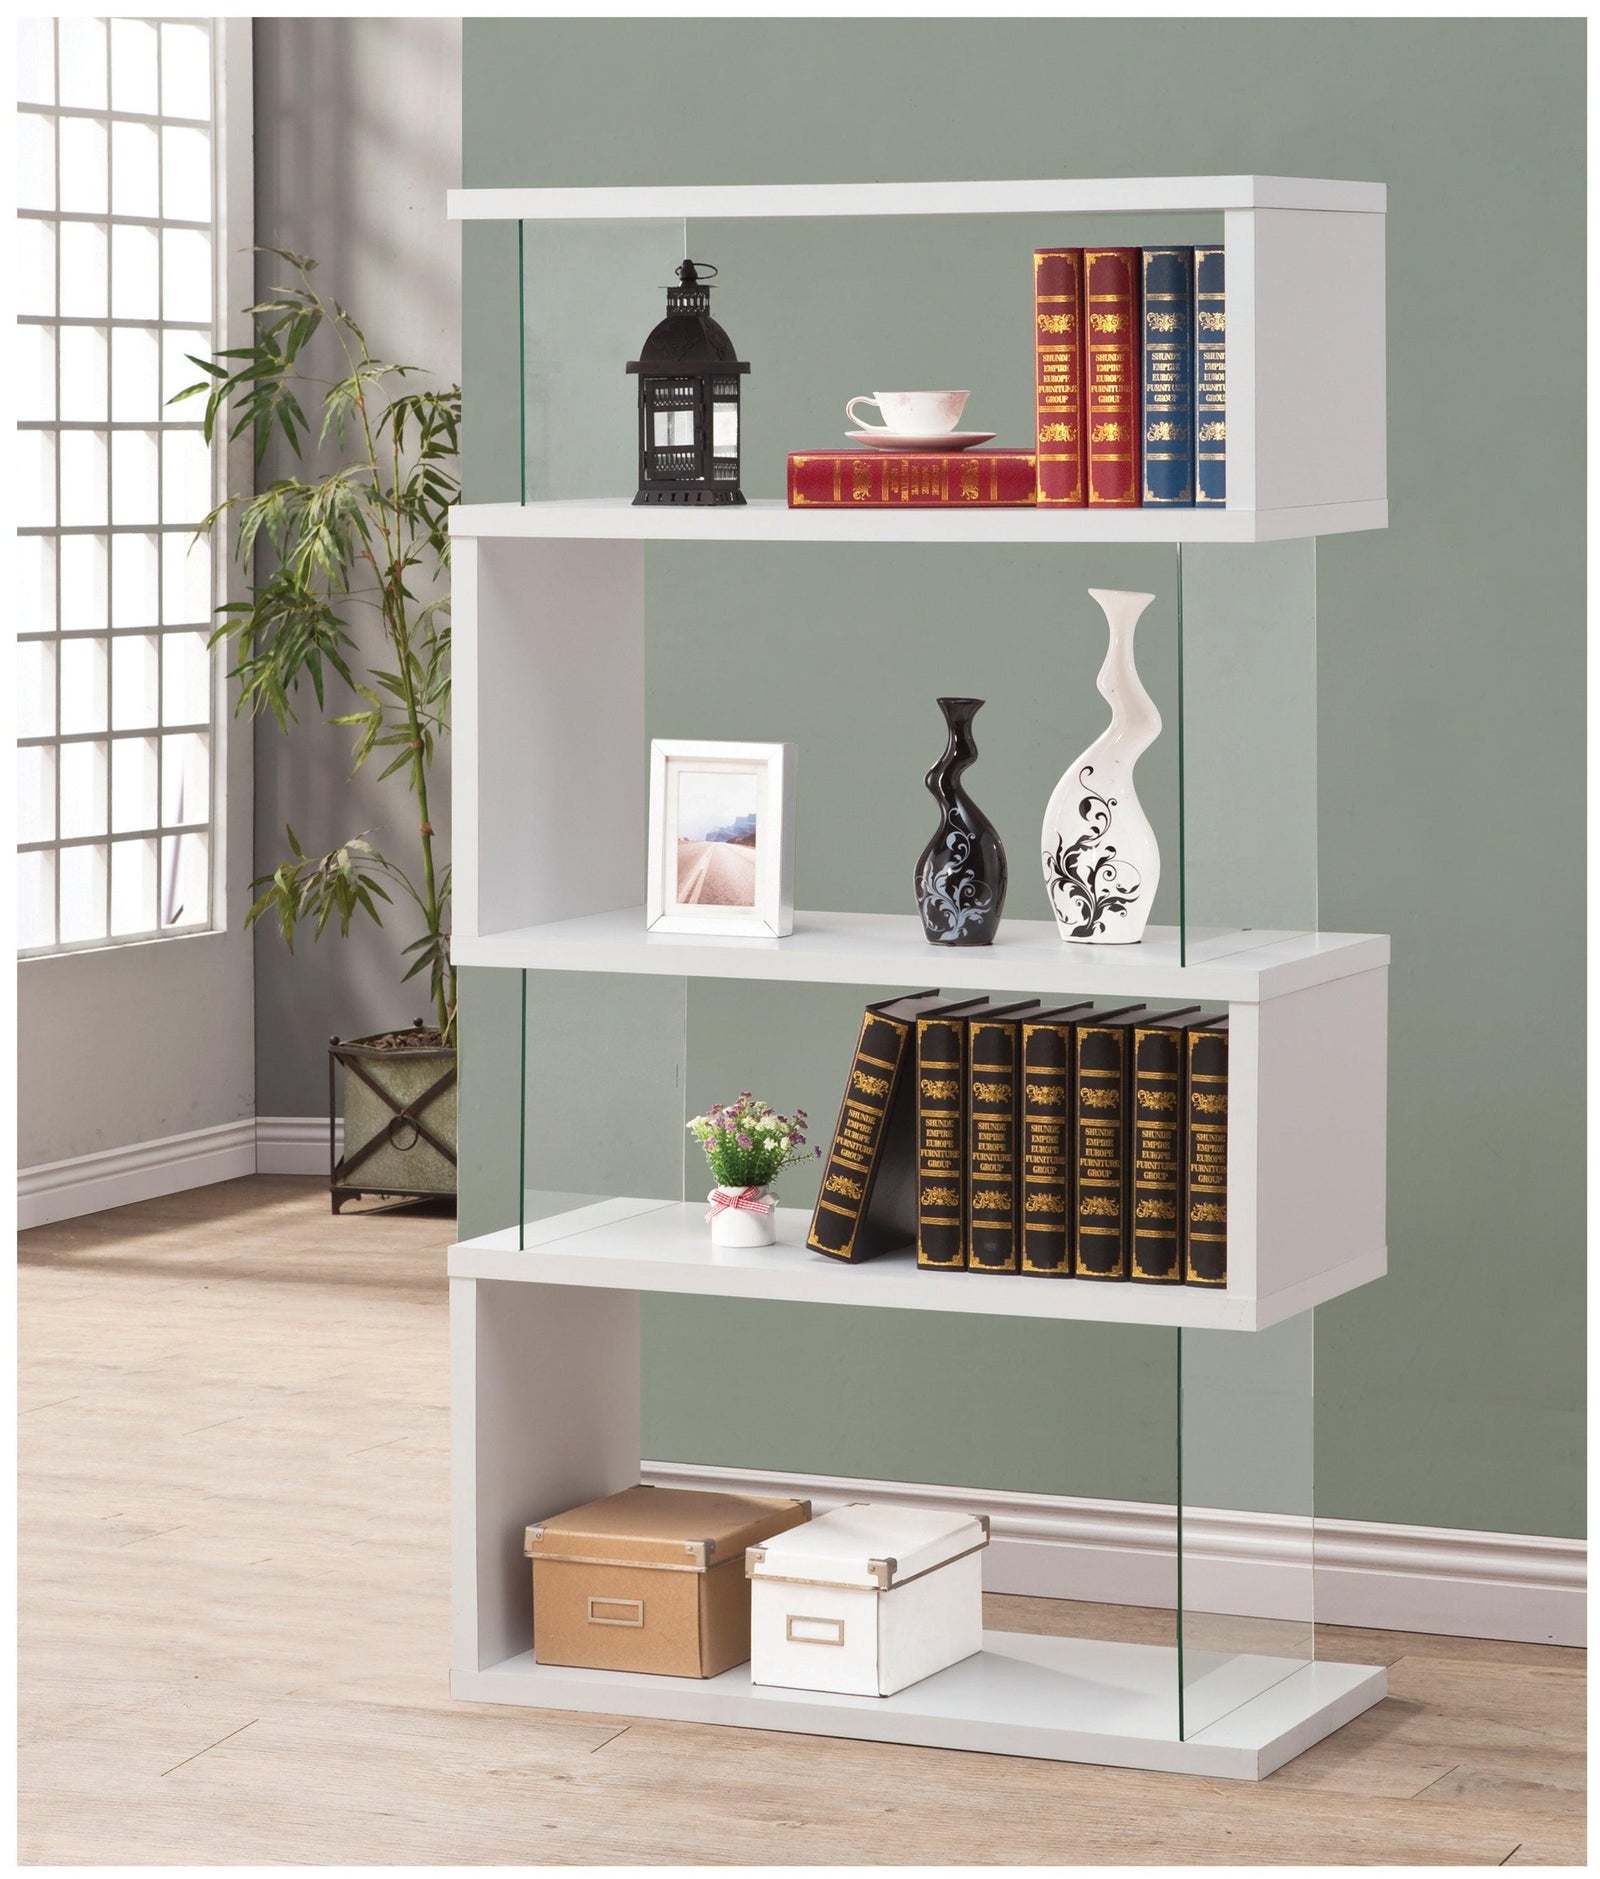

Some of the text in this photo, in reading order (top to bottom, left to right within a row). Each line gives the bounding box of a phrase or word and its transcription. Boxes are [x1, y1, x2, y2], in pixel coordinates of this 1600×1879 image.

[1046, 395, 1068, 403] GROUP
[1206, 394, 1225, 402] GROU
[848, 1109, 876, 1124] SHUNDE
[846, 1119, 872, 1133] EMPIRE
[926, 1119, 954, 1128] SHUNDE
[978, 1122, 1006, 1131] SHUNDE
[1031, 1124, 1060, 1133] SHUNDE
[1085, 1128, 1114, 1136] SHUNDE
[844, 1128, 870, 1144] EUROPE
[926, 1129, 953, 1138] EMPIRE
[979, 1132, 1006, 1141] EMPIRE
[1142, 1130, 1171, 1138] SHUNDE
[1196, 1134, 1226, 1142] SHUNDE
[926, 1139, 954, 1148] EUROPE
[1032, 1134, 1058, 1144] EMPIRE
[1086, 1138, 1114, 1146] EMPIRE
[836, 1136, 874, 1155] FURNITURE
[978, 1142, 1006, 1152] EUROPE
[1142, 1140, 1170, 1149] EMPIRE
[1197, 1144, 1224, 1152] EMPIRE
[920, 1149, 960, 1158] FURNITURE
[1031, 1145, 1059, 1154] EUROPE
[1086, 1148, 1114, 1157] EUROPE
[840, 1148, 864, 1161] GROUP
[972, 1152, 1012, 1162] FURNITURE
[1142, 1150, 1170, 1160] EUROPE
[928, 1160, 952, 1168] GROUP
[1026, 1155, 1065, 1164] FURNITURE
[1080, 1158, 1120, 1168] FURNITURE
[980, 1163, 1004, 1172] GROUP
[1136, 1160, 1176, 1170] FURNITURE
[1190, 1164, 1227, 1174] FURNITUR
[1032, 1166, 1056, 1174] GROUP
[1088, 1169, 1112, 1178] GROUP
[1144, 1172, 1168, 1180] GROUP
[1198, 1174, 1222, 1184] GROUP
